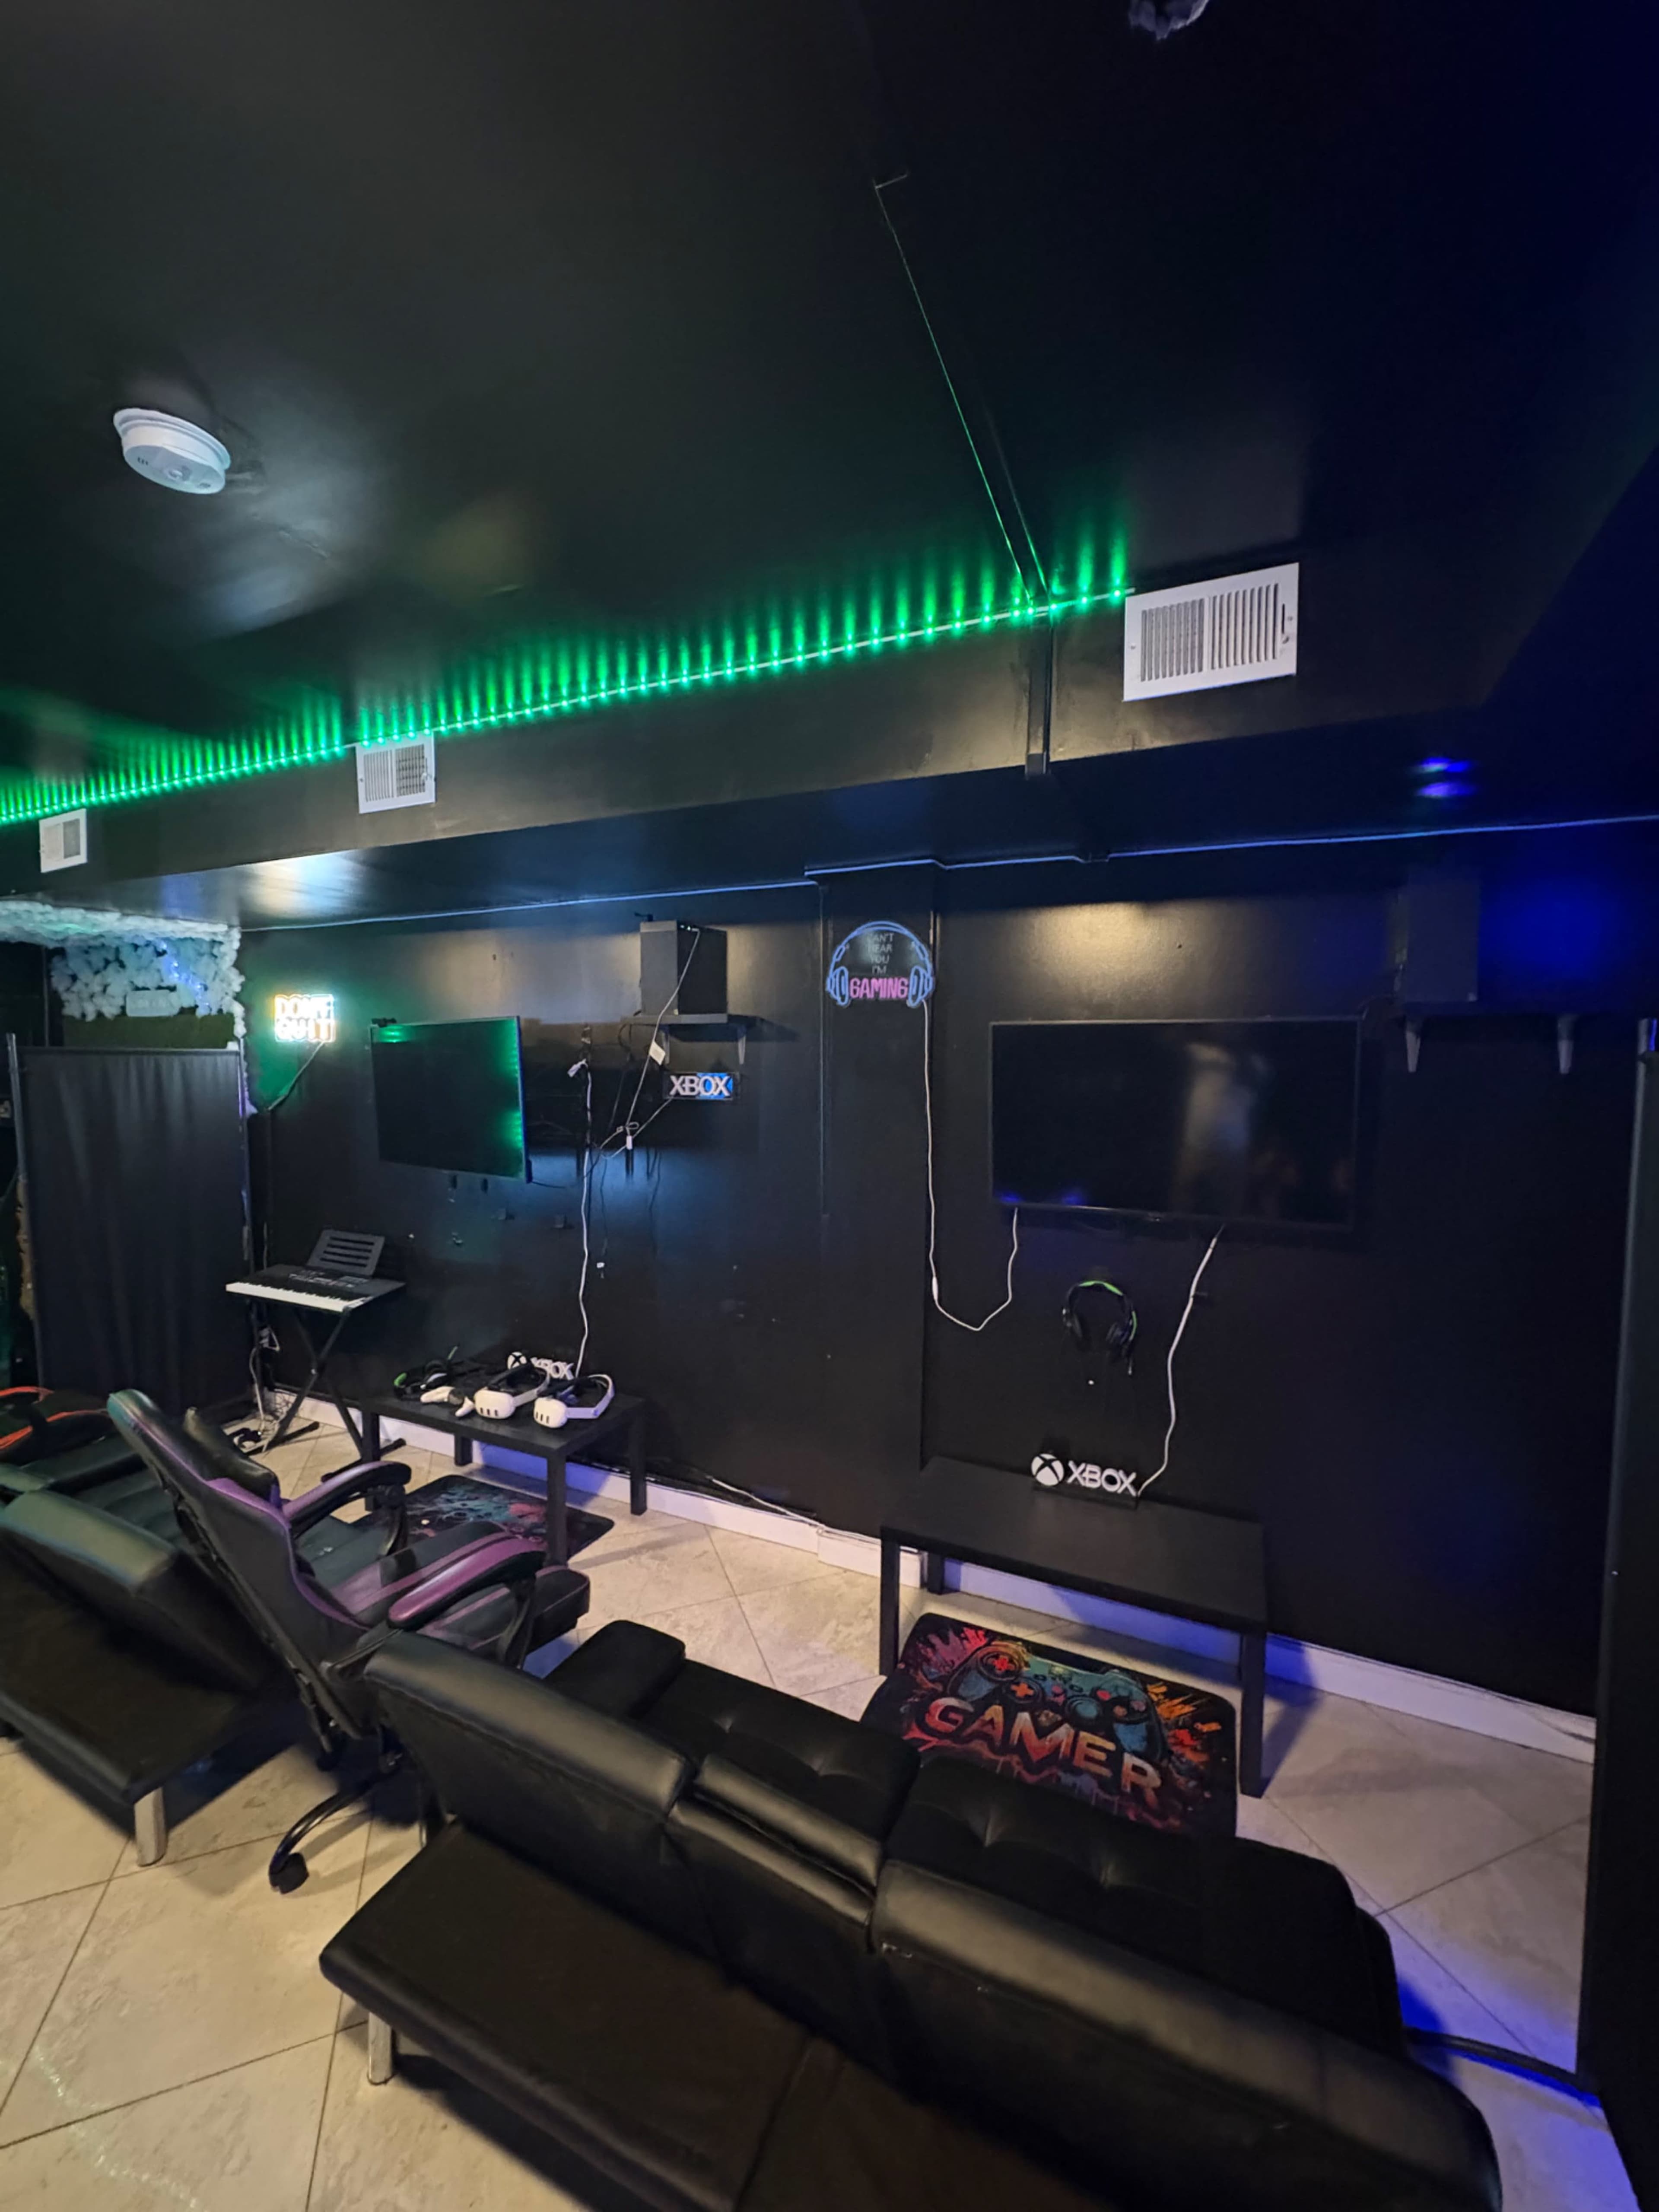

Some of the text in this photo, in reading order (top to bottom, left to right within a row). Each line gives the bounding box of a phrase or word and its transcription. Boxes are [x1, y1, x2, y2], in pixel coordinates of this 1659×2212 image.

[870, 954, 890, 964] YOU
[850, 978, 908, 999] GAMING
[670, 1075, 731, 1096] XBOX
[1067, 1460, 1136, 1497] XBOX
[925, 1697, 1162, 1810] GAMER
